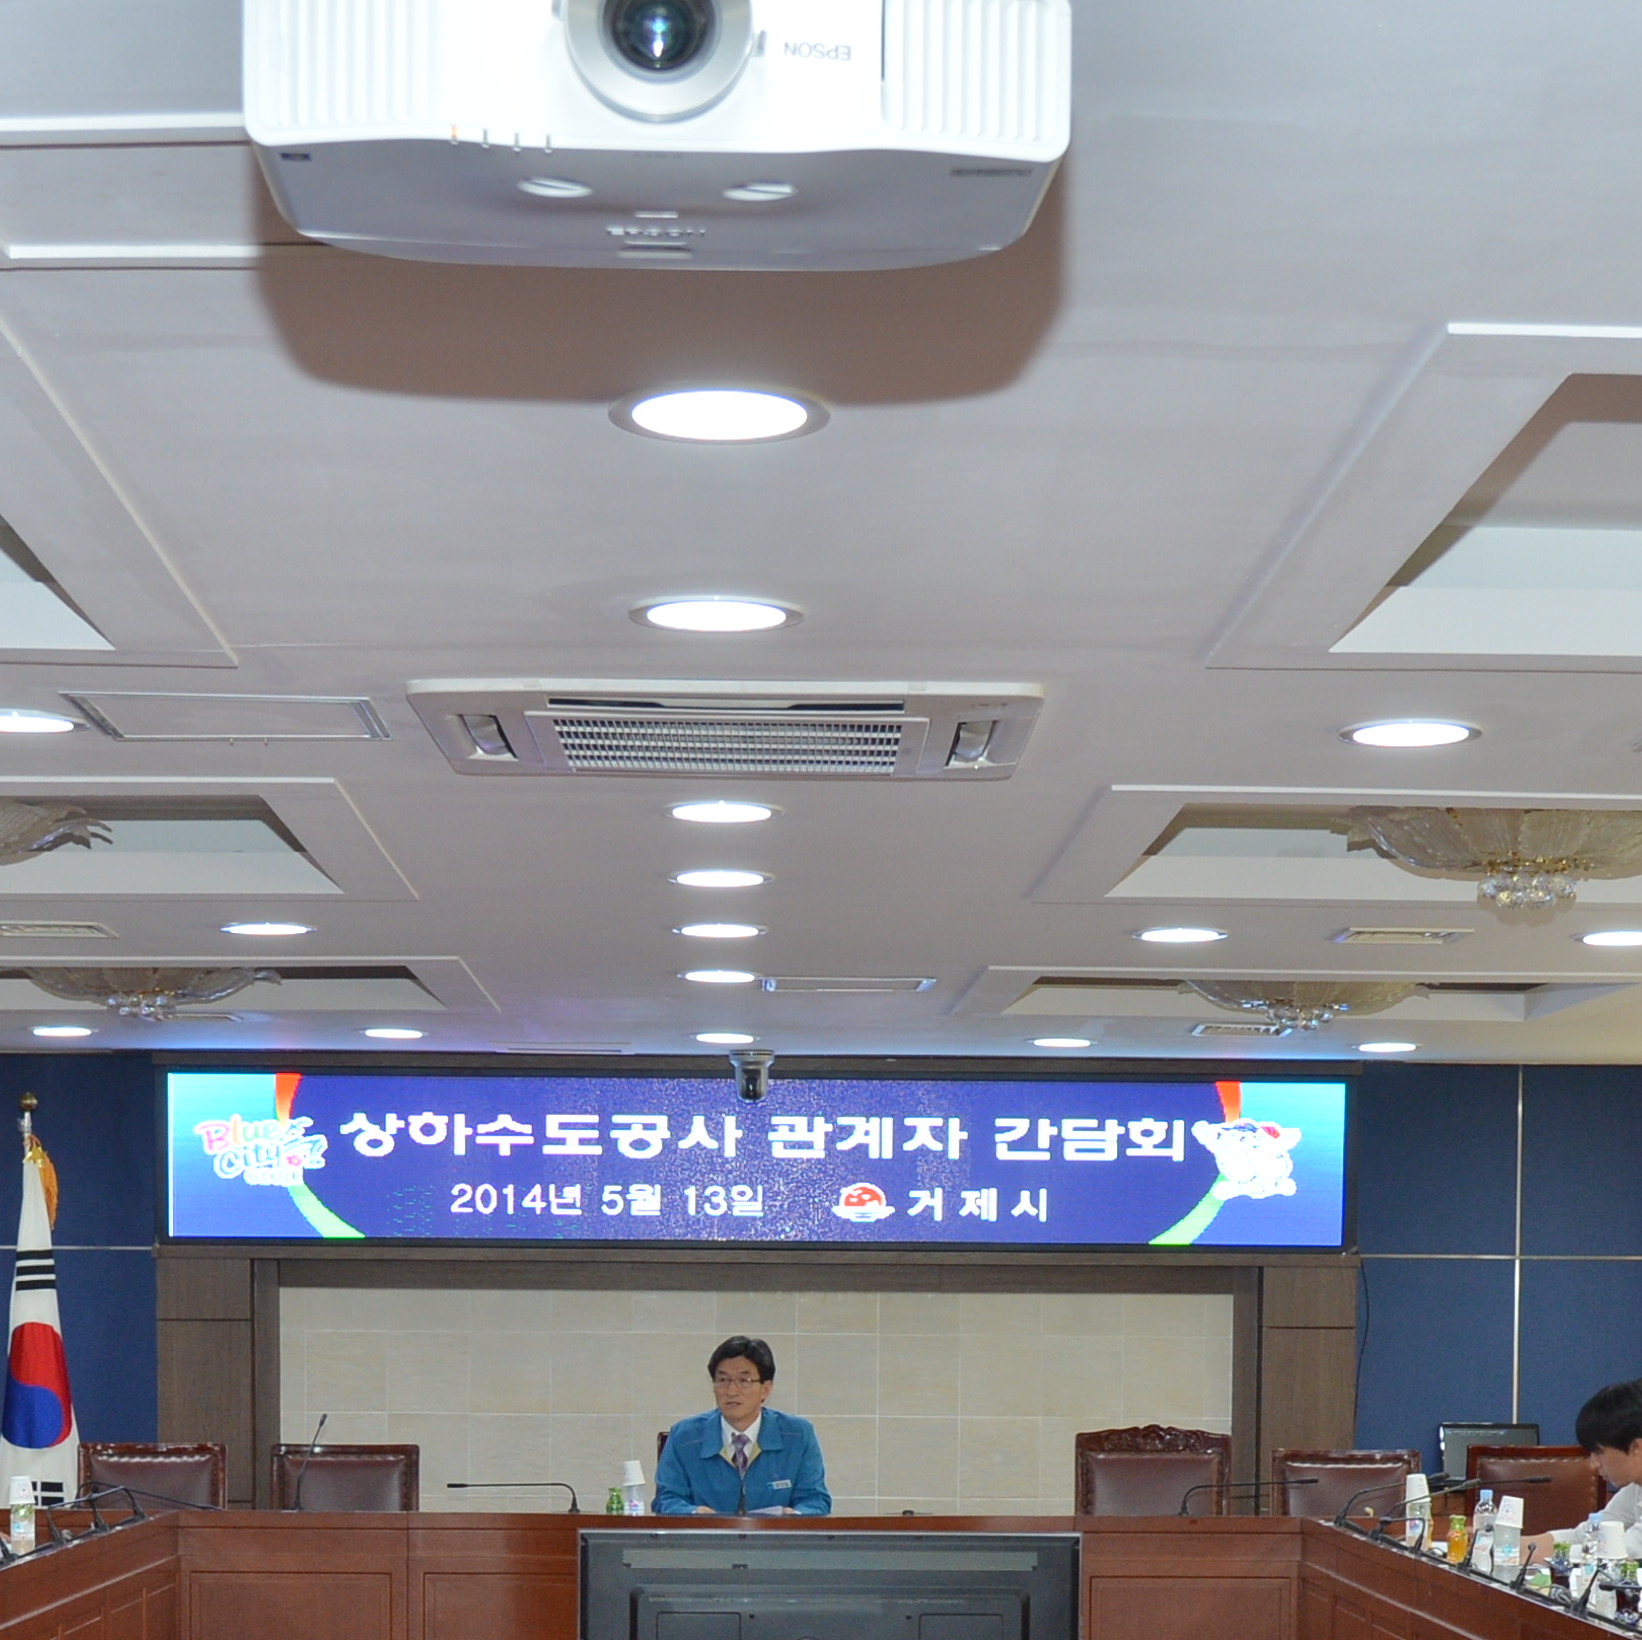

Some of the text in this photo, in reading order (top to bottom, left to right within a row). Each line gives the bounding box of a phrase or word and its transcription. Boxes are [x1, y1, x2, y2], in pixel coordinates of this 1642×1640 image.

[783, 41, 852, 61] EPSON
[196, 1116, 279, 1152] Blue
[340, 1111, 1186, 1162] 상하수도공사 관계자 간담회
[216, 1142, 282, 1177] City
[450, 1183, 765, 1217] 2014년 5월 13일
